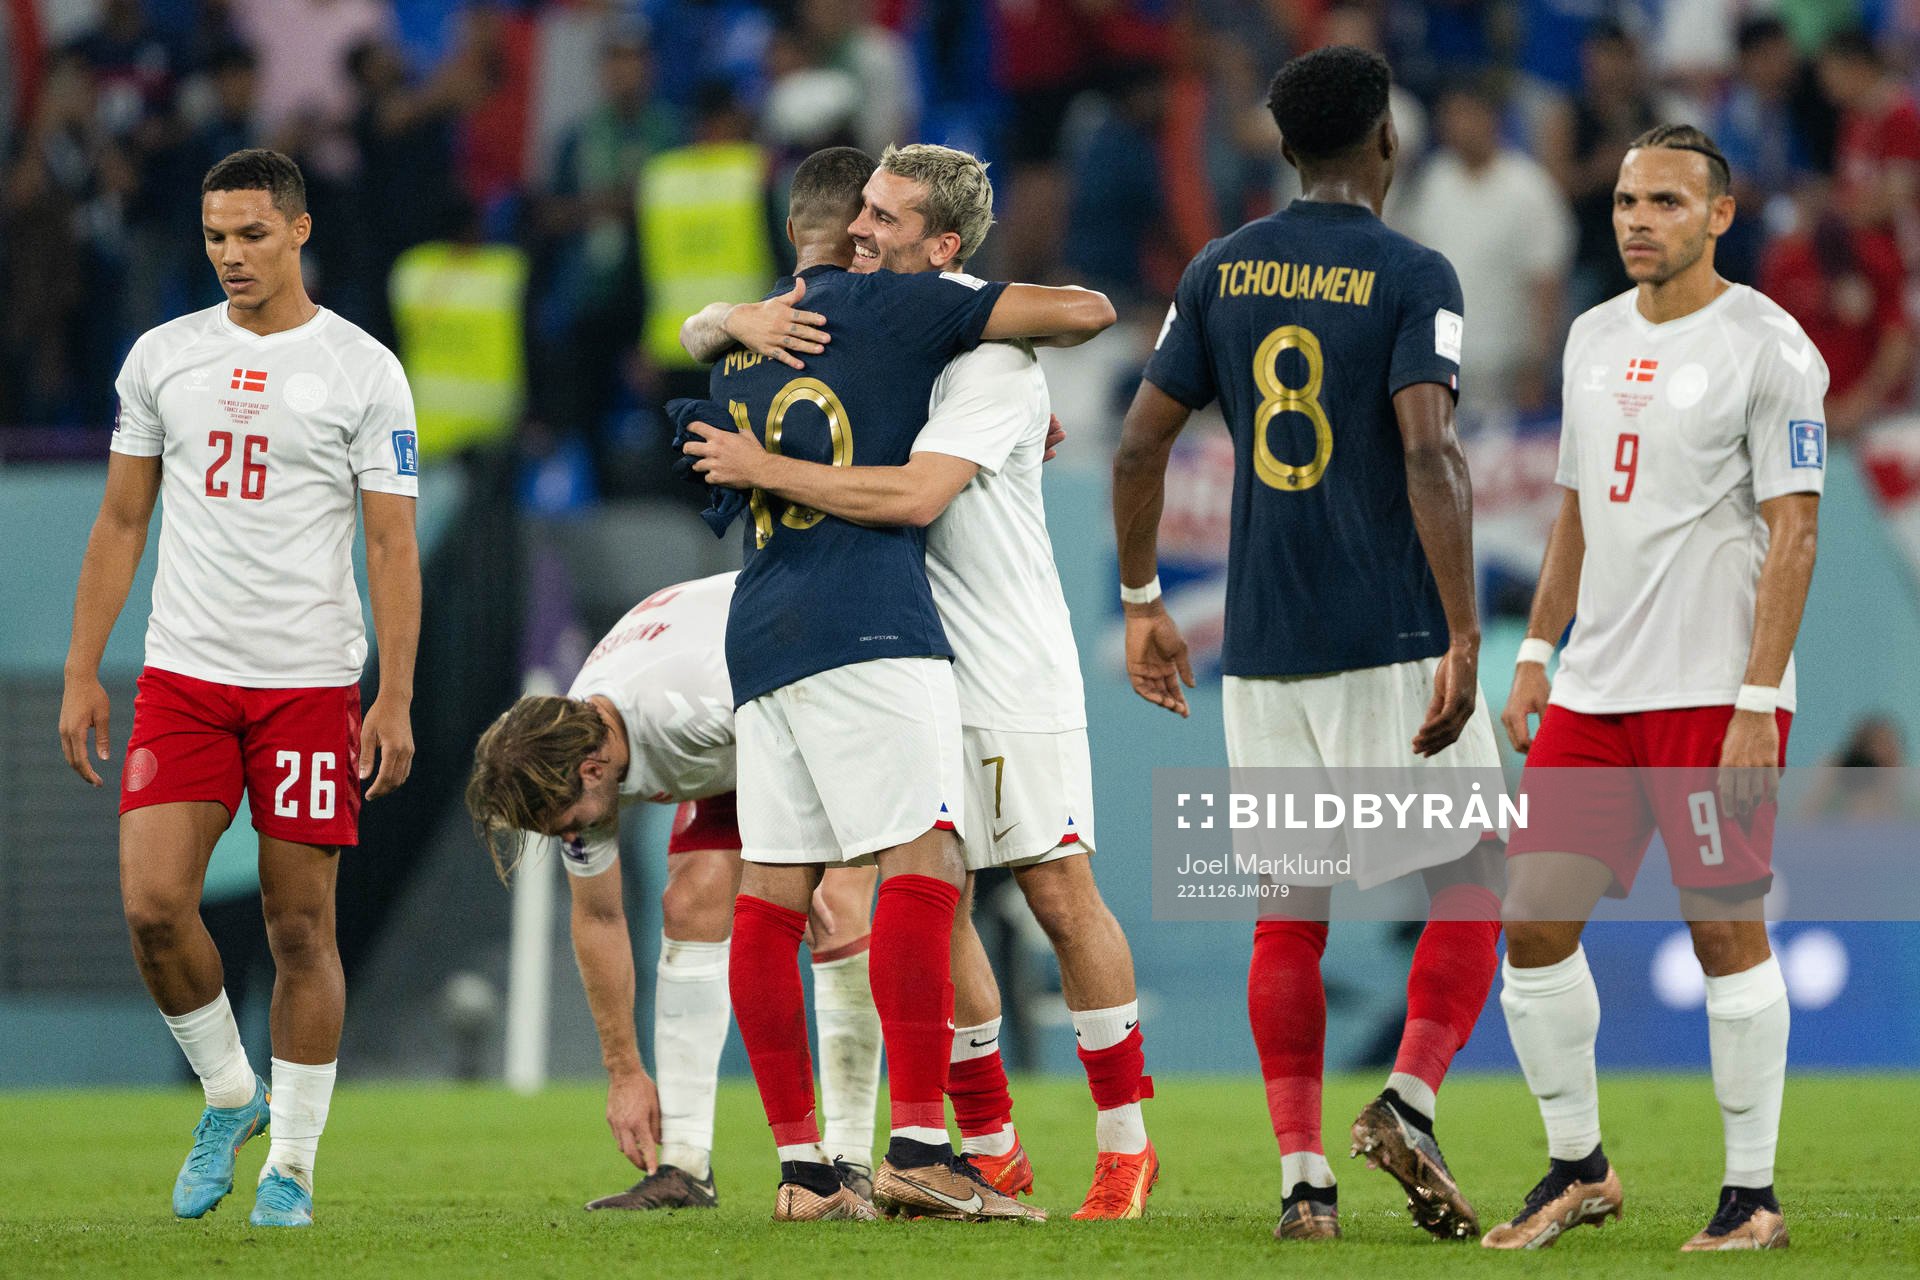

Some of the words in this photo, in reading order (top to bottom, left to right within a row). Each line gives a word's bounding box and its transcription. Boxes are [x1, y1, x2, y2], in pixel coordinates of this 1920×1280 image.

[1218, 260, 1376, 307] TCHOUAMENI
[1253, 324, 1334, 491] 8
[205, 430, 270, 500] 26
[1609, 432, 1639, 502] 9
[274, 750, 336, 819] 26
[981, 756, 1005, 819] 7
[1688, 790, 1725, 866] 9
